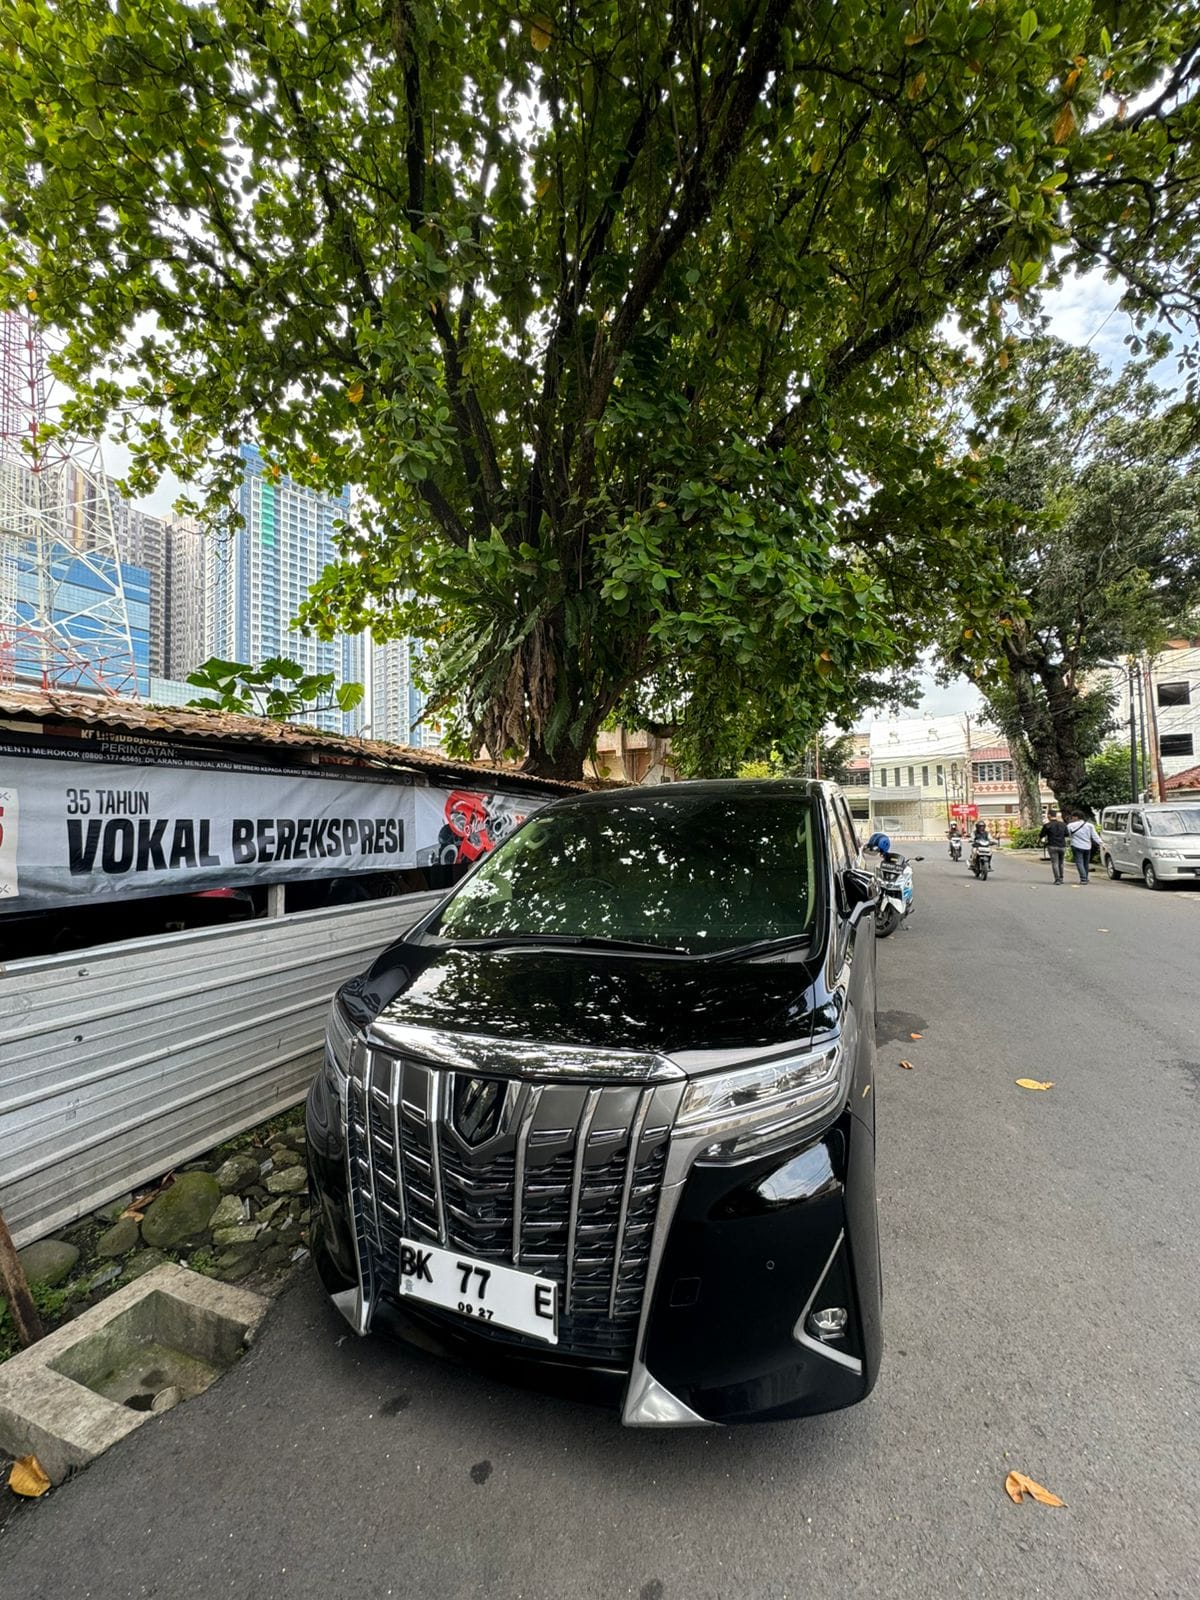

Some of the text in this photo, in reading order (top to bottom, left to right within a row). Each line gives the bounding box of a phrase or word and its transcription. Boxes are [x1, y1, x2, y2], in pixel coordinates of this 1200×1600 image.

[32, 747, 80, 758] MEROKOK
[145, 757, 183, 766] DILARANG
[184, 760, 215, 768] MENJUAL
[233, 764, 260, 772] MEMBERI
[101, 743, 178, 757] PERINGATAN:
[67, 788, 149, 815] 35 TAHUN
[67, 818, 405, 876] VOKAL BEREKSPRESI
[400, 1245, 553, 1320] BK 77 E
[457, 1301, 494, 1321] 09 27
